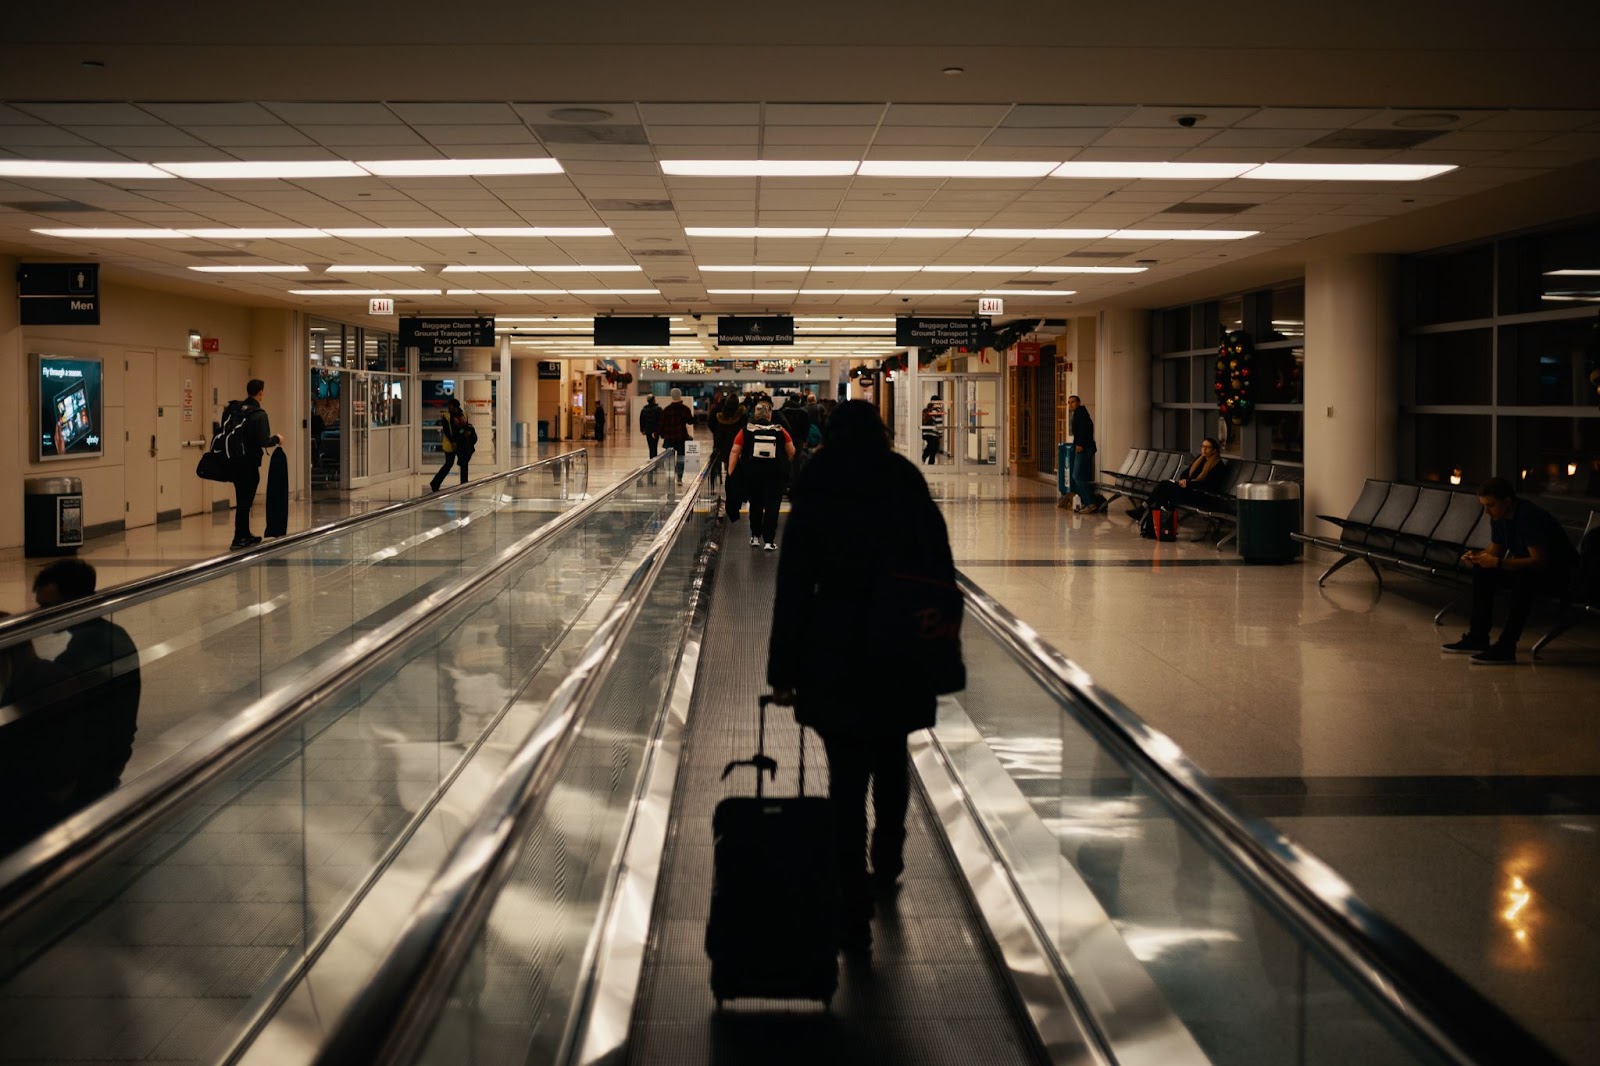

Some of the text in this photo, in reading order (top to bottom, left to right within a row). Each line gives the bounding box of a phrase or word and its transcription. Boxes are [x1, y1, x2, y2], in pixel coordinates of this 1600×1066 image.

[70, 300, 94, 310] Men
[372, 300, 389, 311] EXIT
[982, 300, 999, 311] EXIT
[421, 322, 451, 330] Baggage
[919, 322, 949, 330] Baggage
[440, 330, 472, 338] Transport
[937, 330, 969, 338] Transport
[719, 334, 793, 343] Moving Walkway Ends
